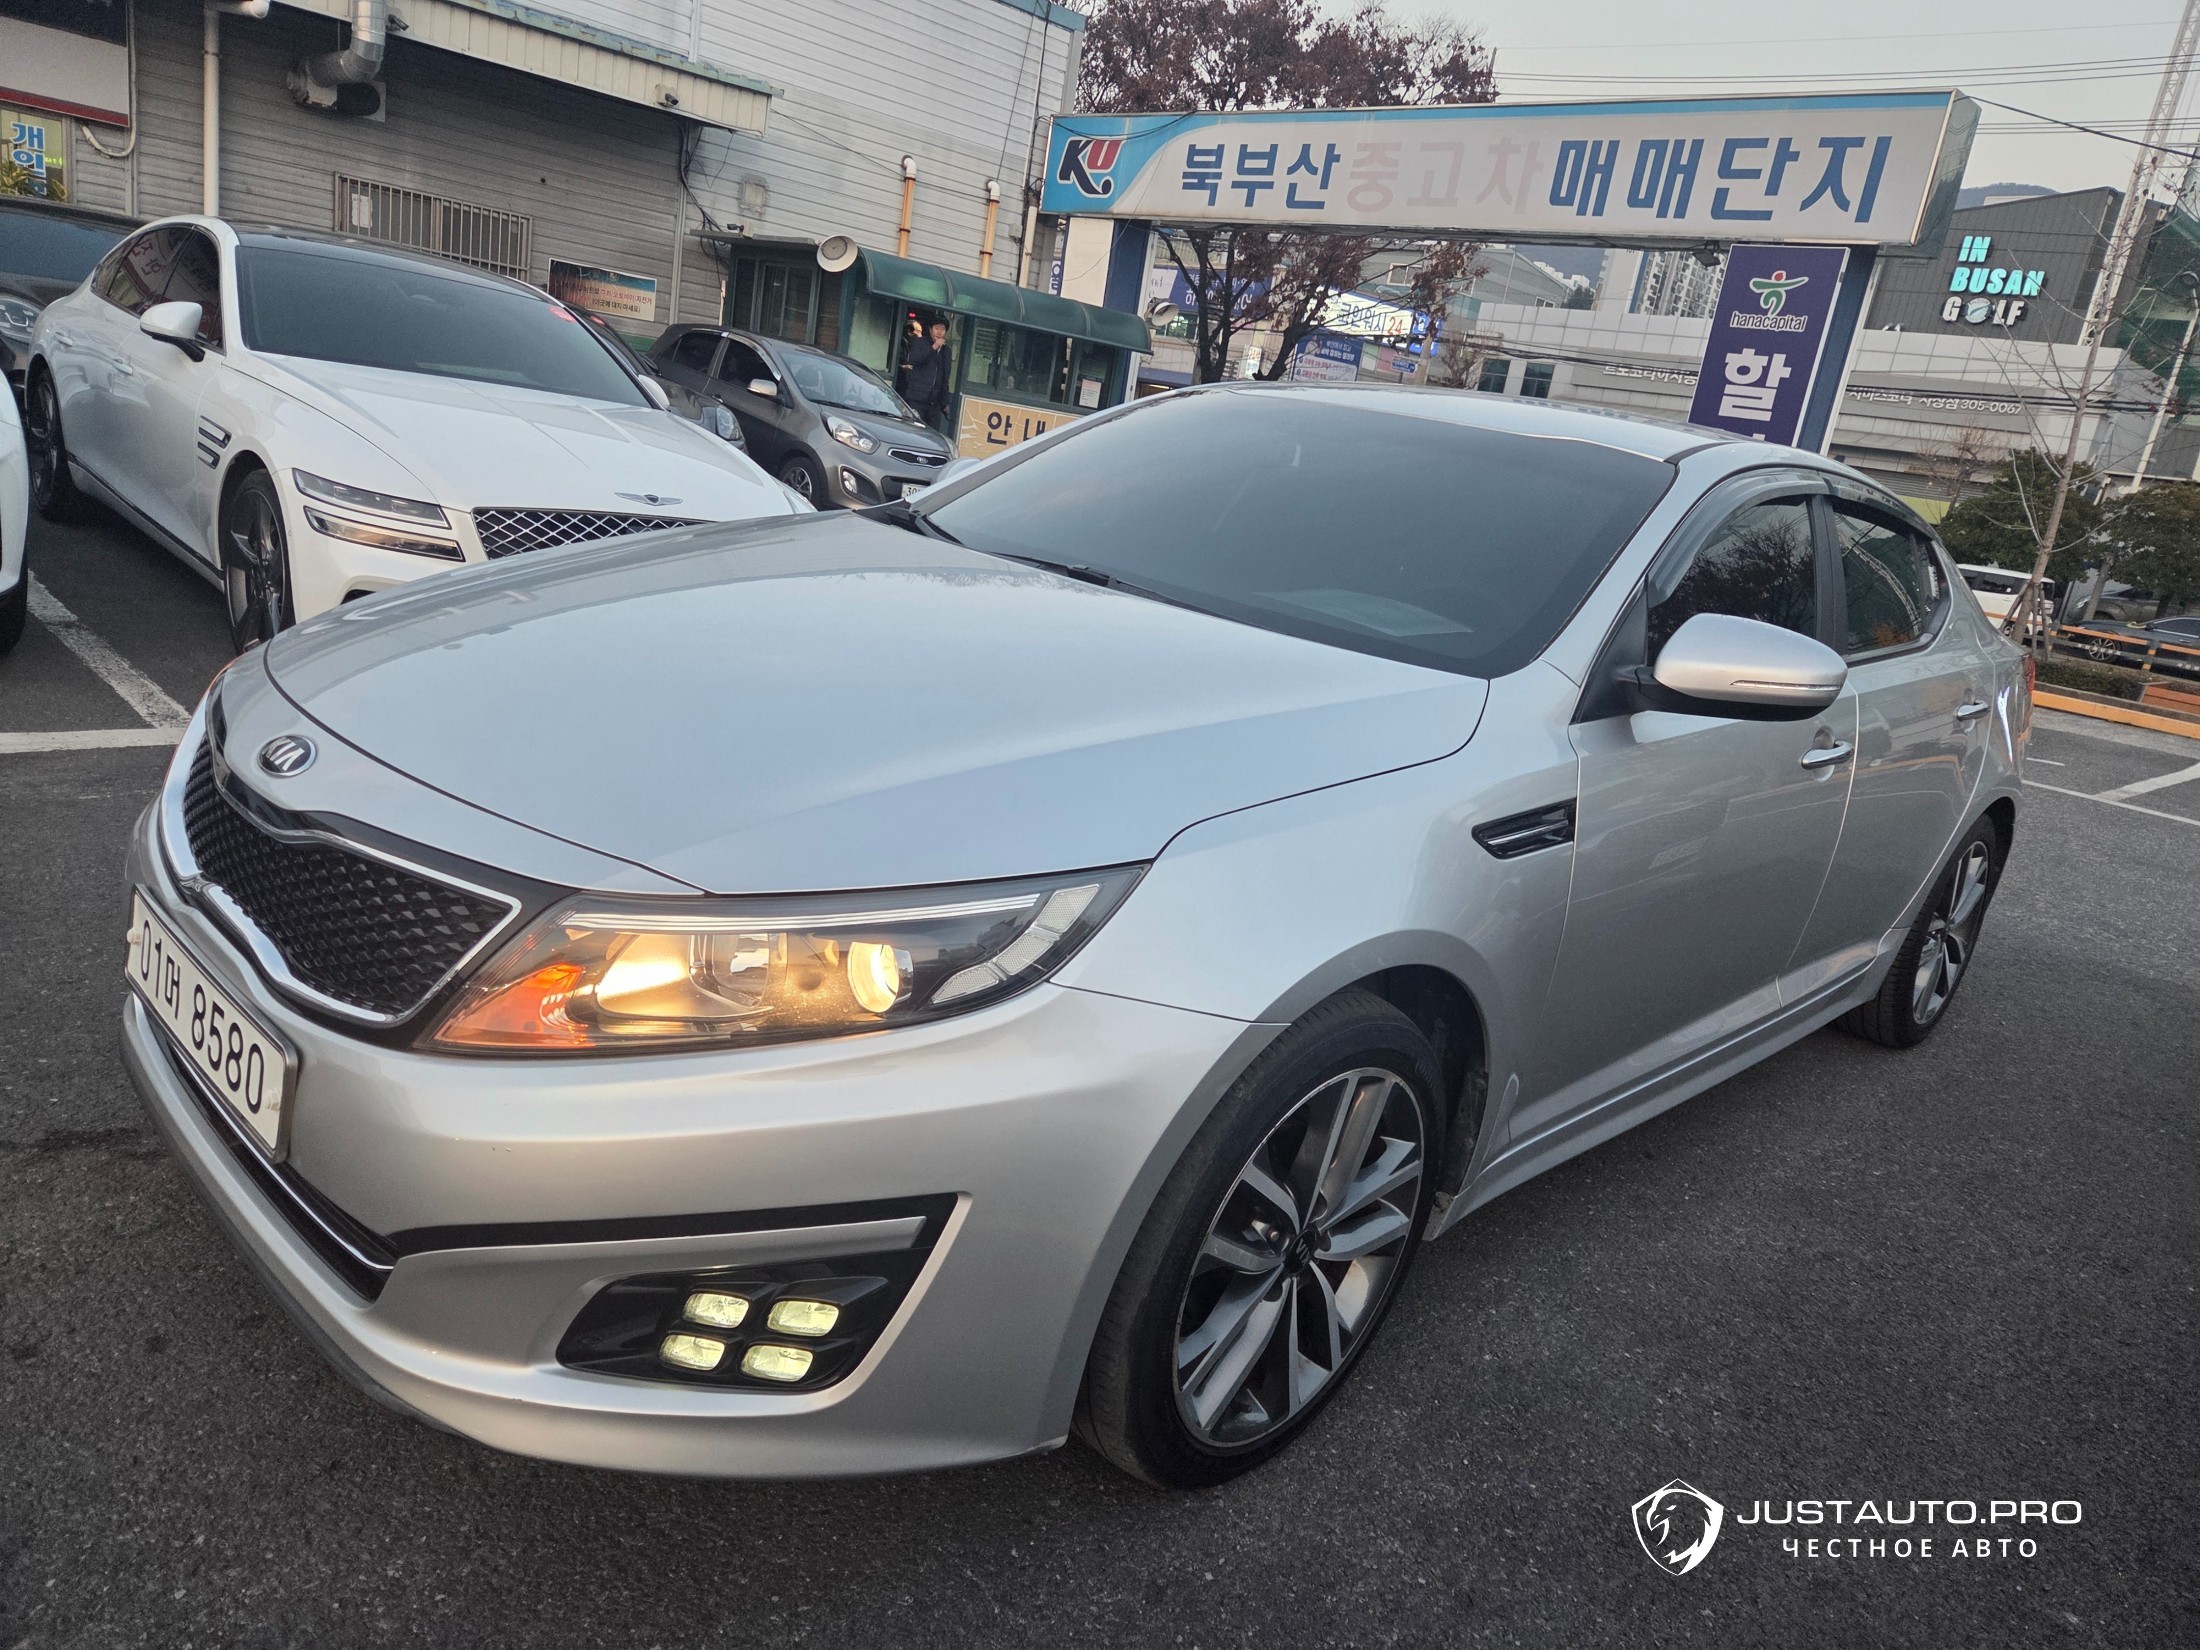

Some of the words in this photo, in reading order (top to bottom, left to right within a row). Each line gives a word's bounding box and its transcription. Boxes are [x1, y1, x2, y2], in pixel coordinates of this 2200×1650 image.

[1058, 137, 1125, 197] KU
[1181, 142, 1342, 210] 북부산
[1346, 137, 1545, 214] 중고차
[1548, 135, 1893, 224] 매매단지
[1957, 235, 1992, 263] IN
[1949, 266, 2046, 296] BUSAN
[1730, 311, 1808, 332] hanacapital
[1718, 348, 1792, 441] 할
[1960, 399, 2023, 415] 305-0067
[191, 983, 265, 1115] 8580
